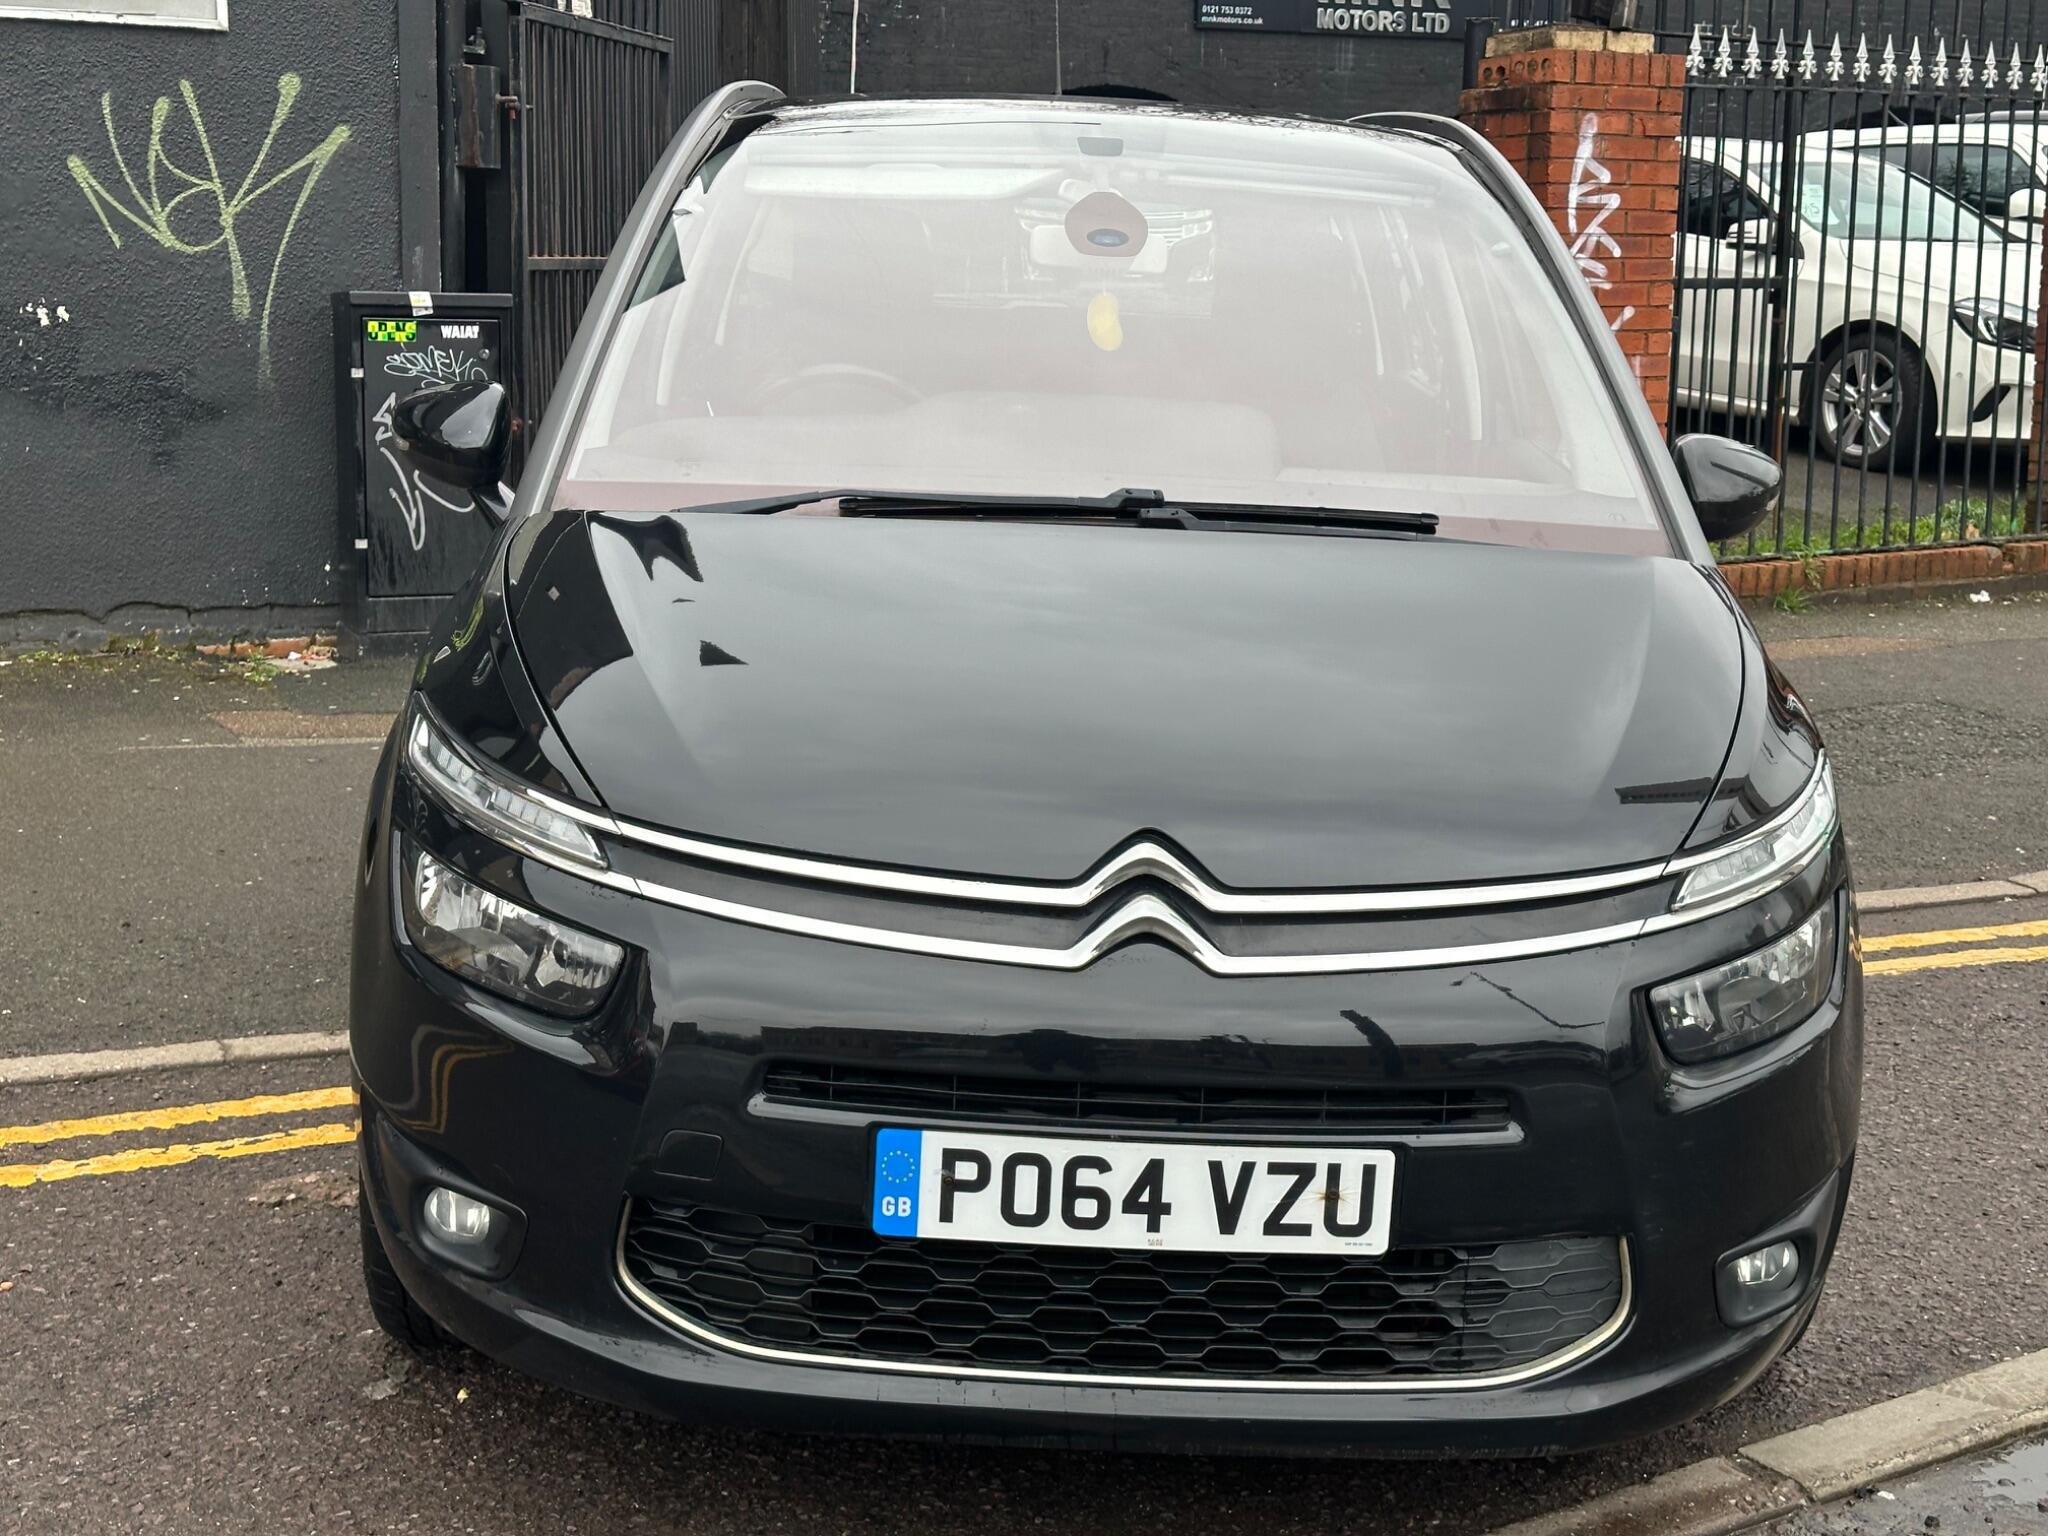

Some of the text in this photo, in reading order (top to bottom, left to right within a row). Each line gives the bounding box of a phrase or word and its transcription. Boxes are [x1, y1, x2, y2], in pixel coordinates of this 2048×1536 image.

[1201, 5, 1253, 15] 0121 753 0372
[1201, 15, 1264, 25] mnkmotors.co.uk
[1316, 8, 1451, 33] MOTORS LTD
[939, 1147, 1377, 1238] PO64 VZU
[881, 1195, 911, 1217] GB
